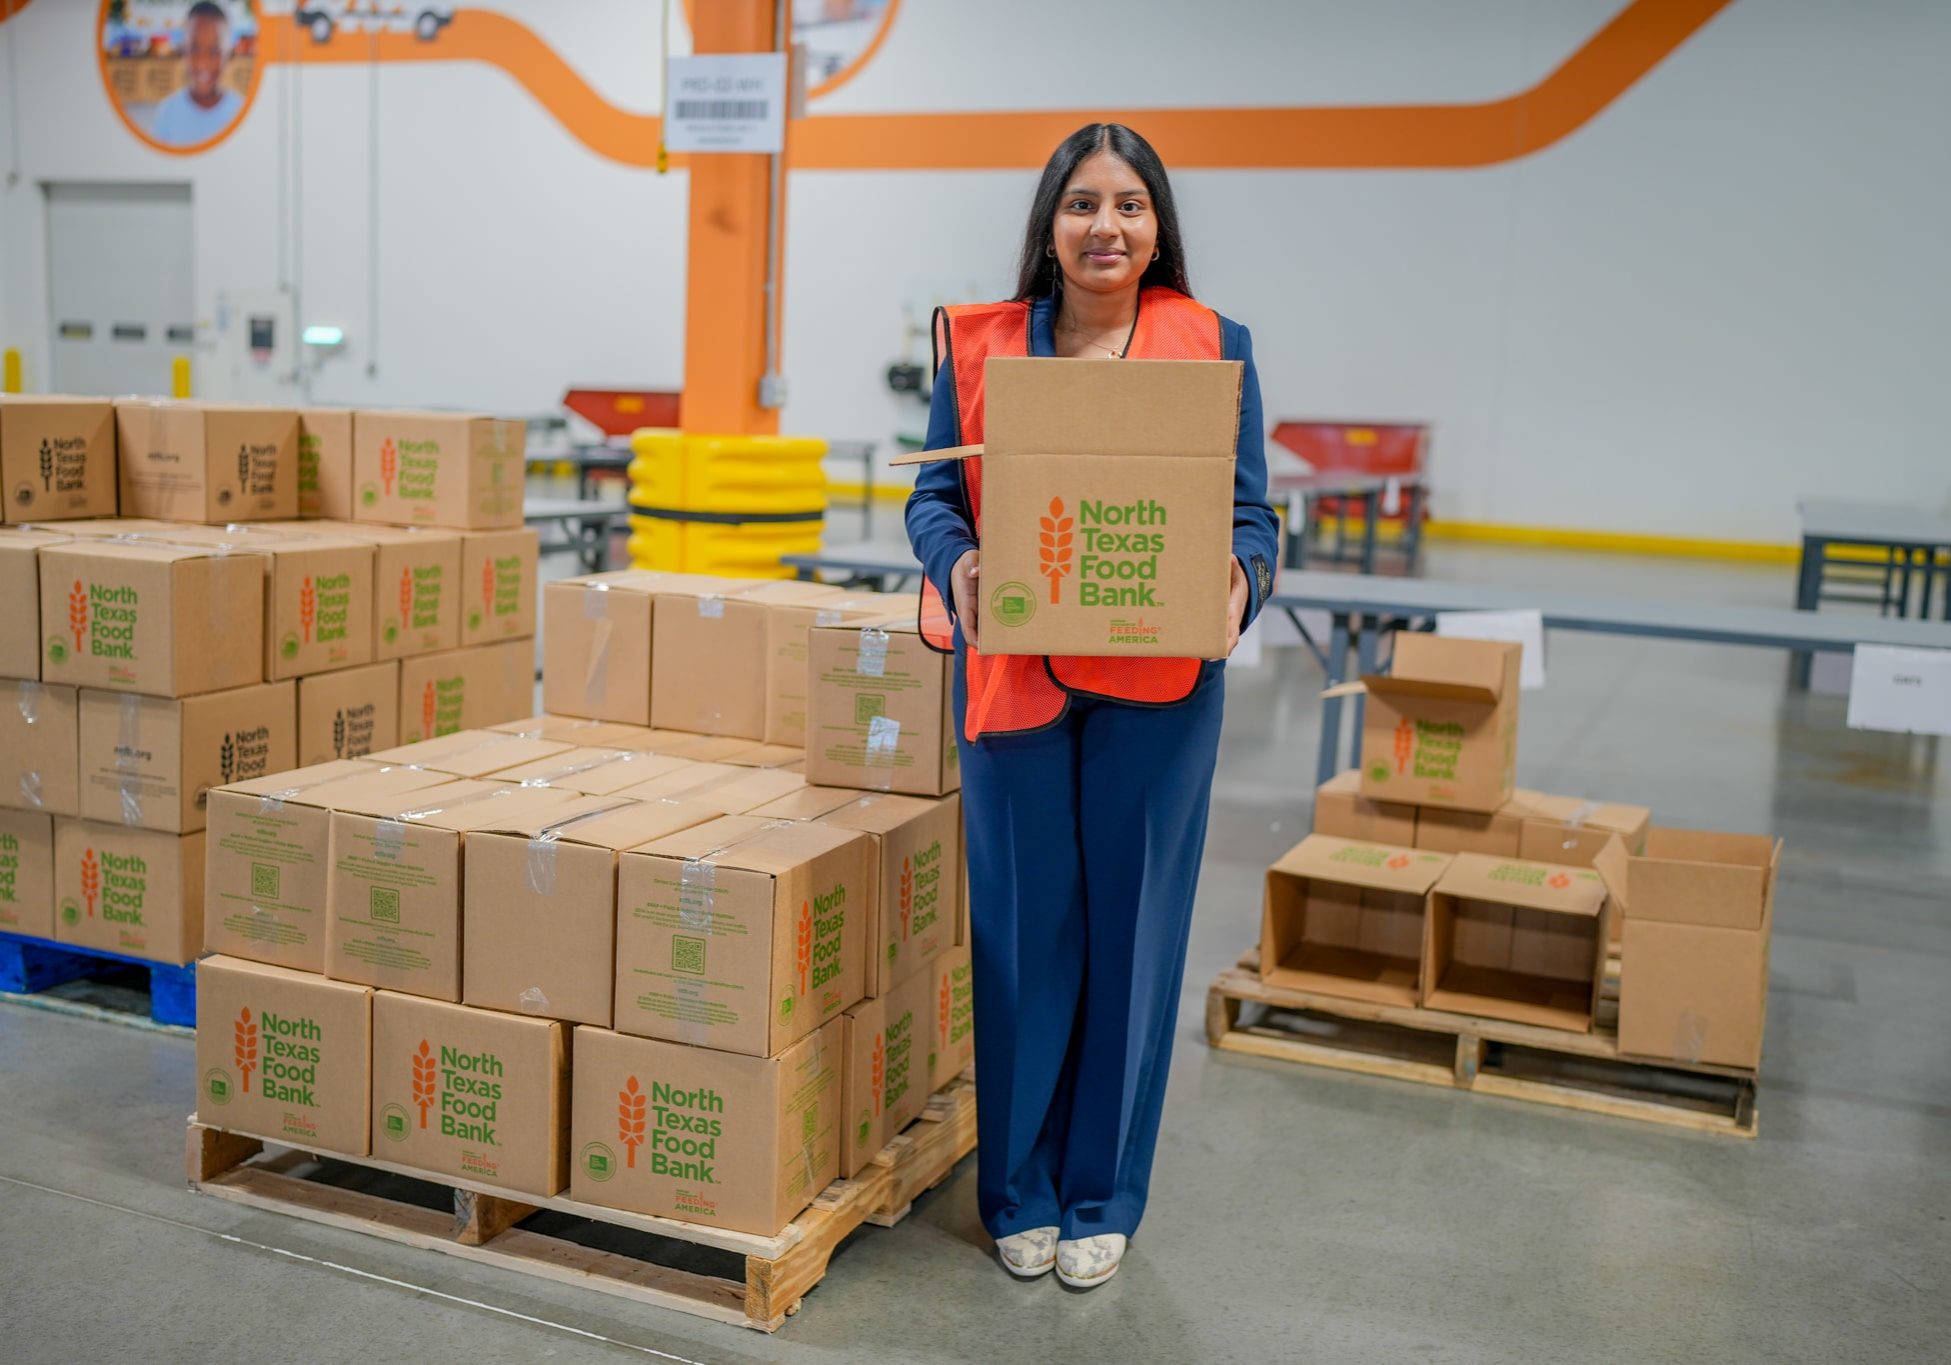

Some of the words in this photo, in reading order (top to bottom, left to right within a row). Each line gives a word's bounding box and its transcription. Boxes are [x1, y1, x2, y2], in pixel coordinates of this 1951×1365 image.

[1080, 500, 1166, 525] North
[1080, 528, 1165, 552] Texas
[1080, 555, 1157, 580] Food
[90, 583, 138, 604] North
[91, 603, 137, 624] Texas
[91, 621, 134, 641] Food
[1108, 635, 1158, 644] AMERICA
[1110, 626, 1161, 634] FEEDING
[101, 851, 147, 875] North
[913, 840, 941, 871] North
[101, 869, 146, 892] Texas
[914, 864, 940, 891] Texas
[102, 887, 144, 909] Food
[814, 883, 845, 920] North
[913, 882, 938, 914] Food
[814, 910, 845, 941] Texas
[813, 930, 842, 966] Food
[262, 1011, 321, 1042] North
[262, 1033, 320, 1064] Texas
[440, 1045, 503, 1078] North
[262, 1056, 316, 1085] Food
[441, 1069, 502, 1100] Texas
[441, 1092, 497, 1123] Food
[652, 1080, 723, 1114] North
[652, 1105, 722, 1138] Texas
[652, 1129, 716, 1161] Food
[674, 1203, 717, 1217] AMERICA
